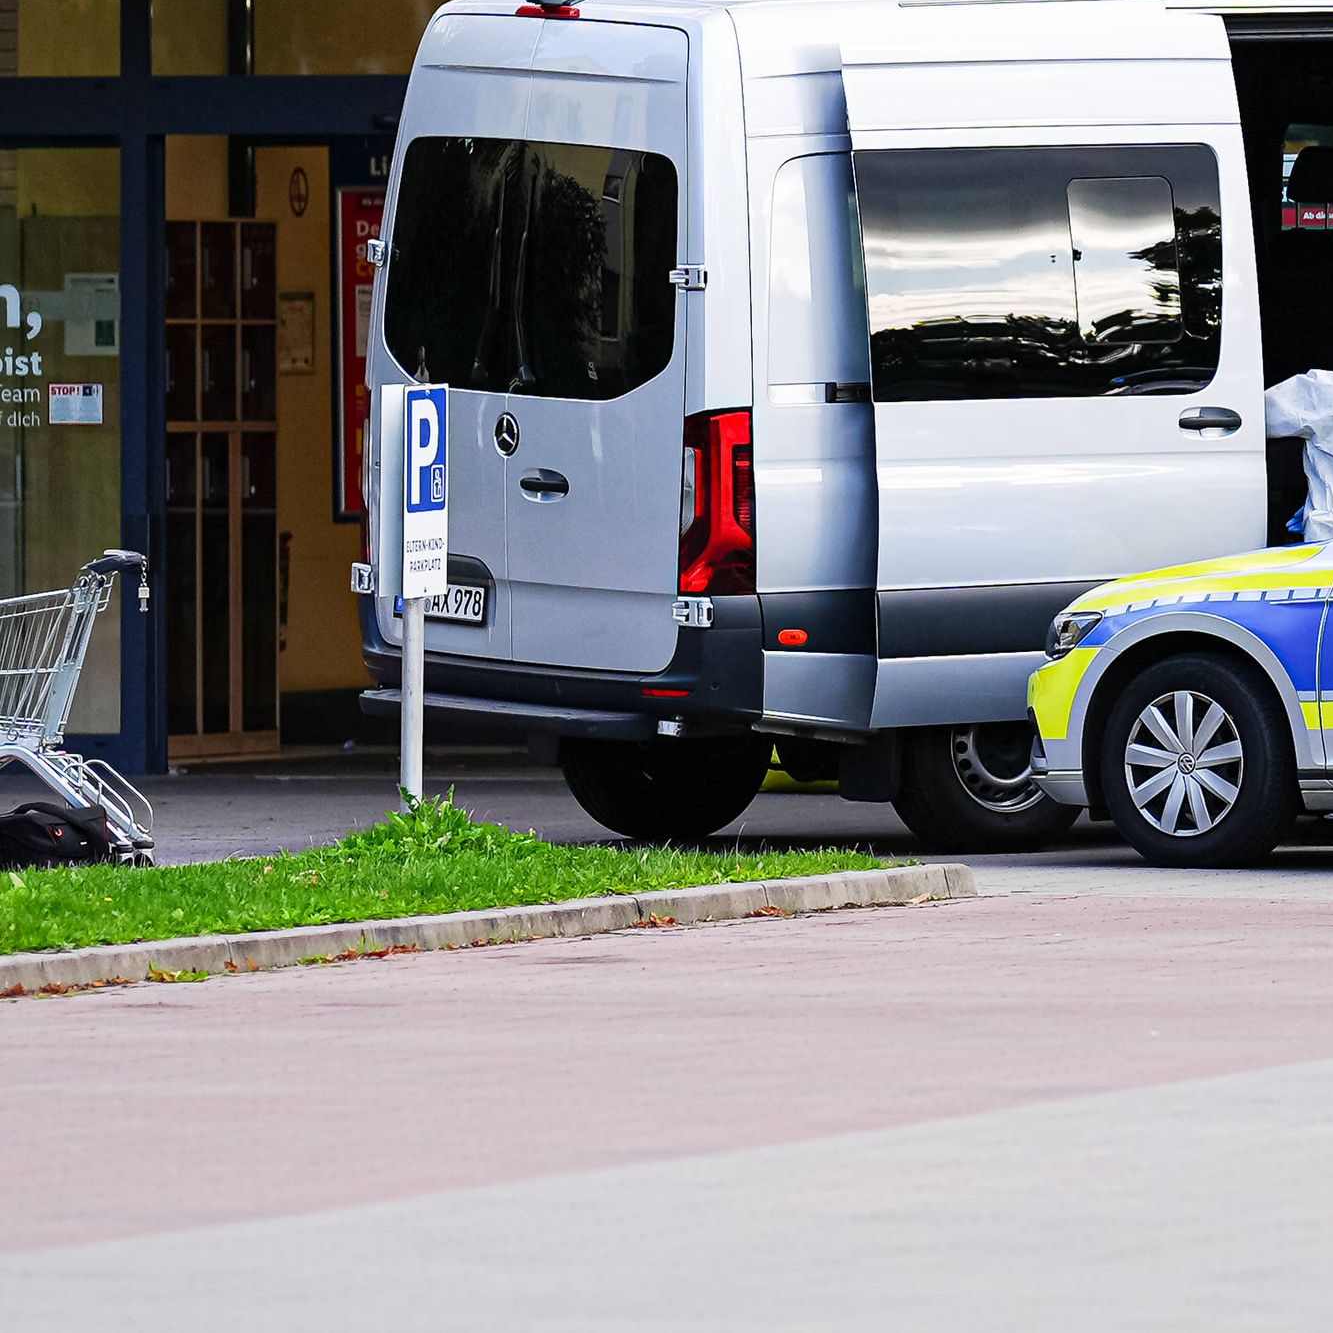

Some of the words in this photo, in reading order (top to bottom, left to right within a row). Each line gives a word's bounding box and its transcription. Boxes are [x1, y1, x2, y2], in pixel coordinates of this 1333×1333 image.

[0, 347, 42, 376] ist
[0, 384, 40, 403] eam
[7, 412, 40, 427] dich
[411, 399, 439, 505] P
[410, 558, 441, 573] PARKPLATZ
[454, 588, 482, 617] 978
